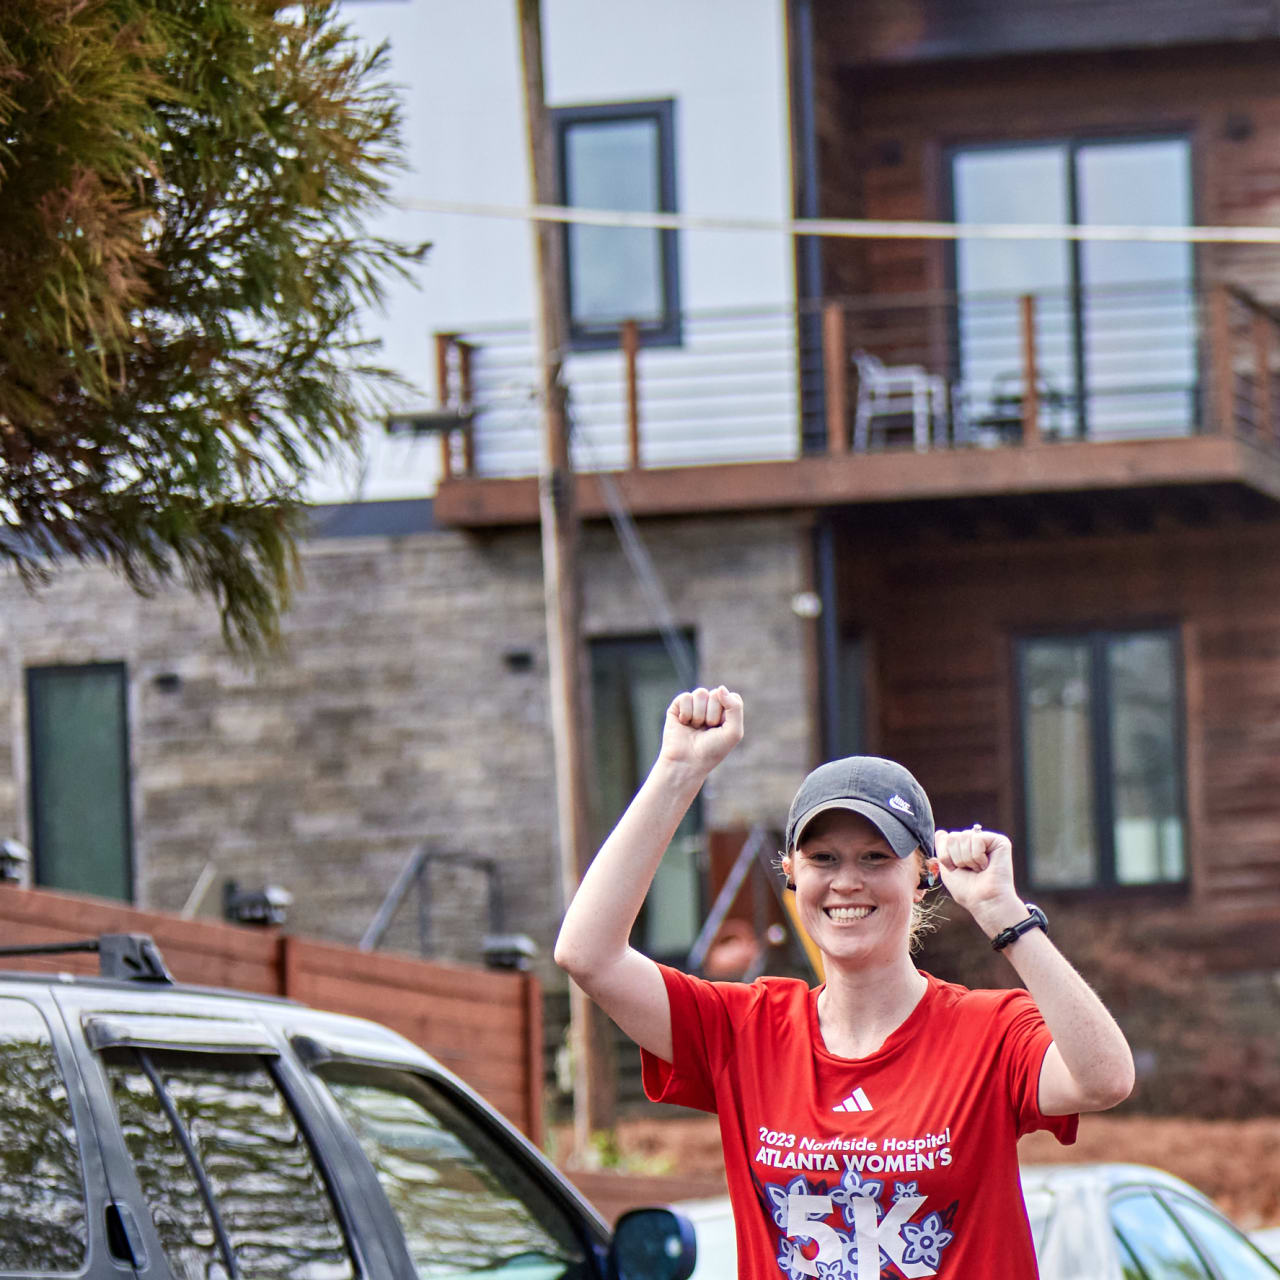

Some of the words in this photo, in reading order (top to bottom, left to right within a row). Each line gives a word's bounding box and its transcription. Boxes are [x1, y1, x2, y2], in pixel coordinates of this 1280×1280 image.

[758, 1126, 796, 1149] 2023
[799, 1136, 878, 1152] Northside
[882, 1127, 951, 1156] Hospital
[755, 1145, 840, 1171] ATLANTA
[843, 1147, 953, 1173] WOMEN'S
[786, 1194, 938, 1280] 5K
